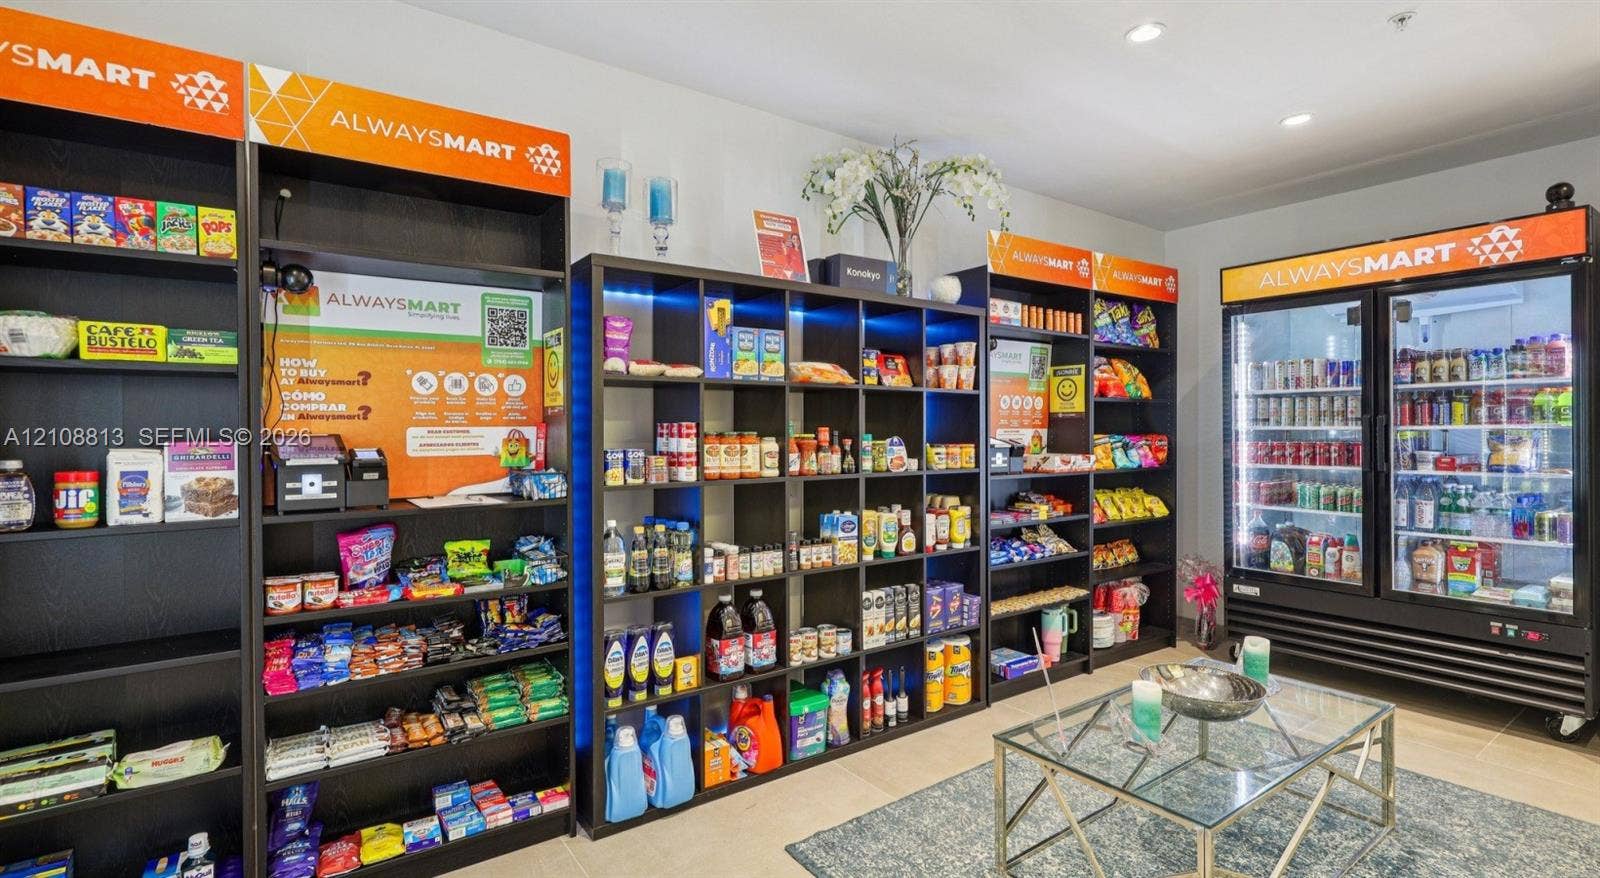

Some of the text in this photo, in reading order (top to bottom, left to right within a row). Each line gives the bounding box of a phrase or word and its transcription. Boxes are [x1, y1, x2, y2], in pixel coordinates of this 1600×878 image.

[329, 110, 517, 161] ALWAYSMART
[162, 219, 193, 233] JACKS
[201, 221, 232, 235] POPS
[1012, 251, 1074, 271] ALWAYSMART
[1258, 242, 1457, 290] ALWAYSMART
[846, 267, 881, 280] Konakyo
[1113, 270, 1162, 287] ALWAYSMART
[326, 293, 462, 314] ALWAYSMART
[86, 336, 158, 349] BUSTELO
[182, 336, 208, 344] GREEN
[280, 358, 318, 368] HOW
[280, 368, 327, 377] TO BUY
[281, 403, 347, 412] COMPRAR
[308, 589, 334, 597] nutella
[151, 756, 185, 768] HUGGIES
